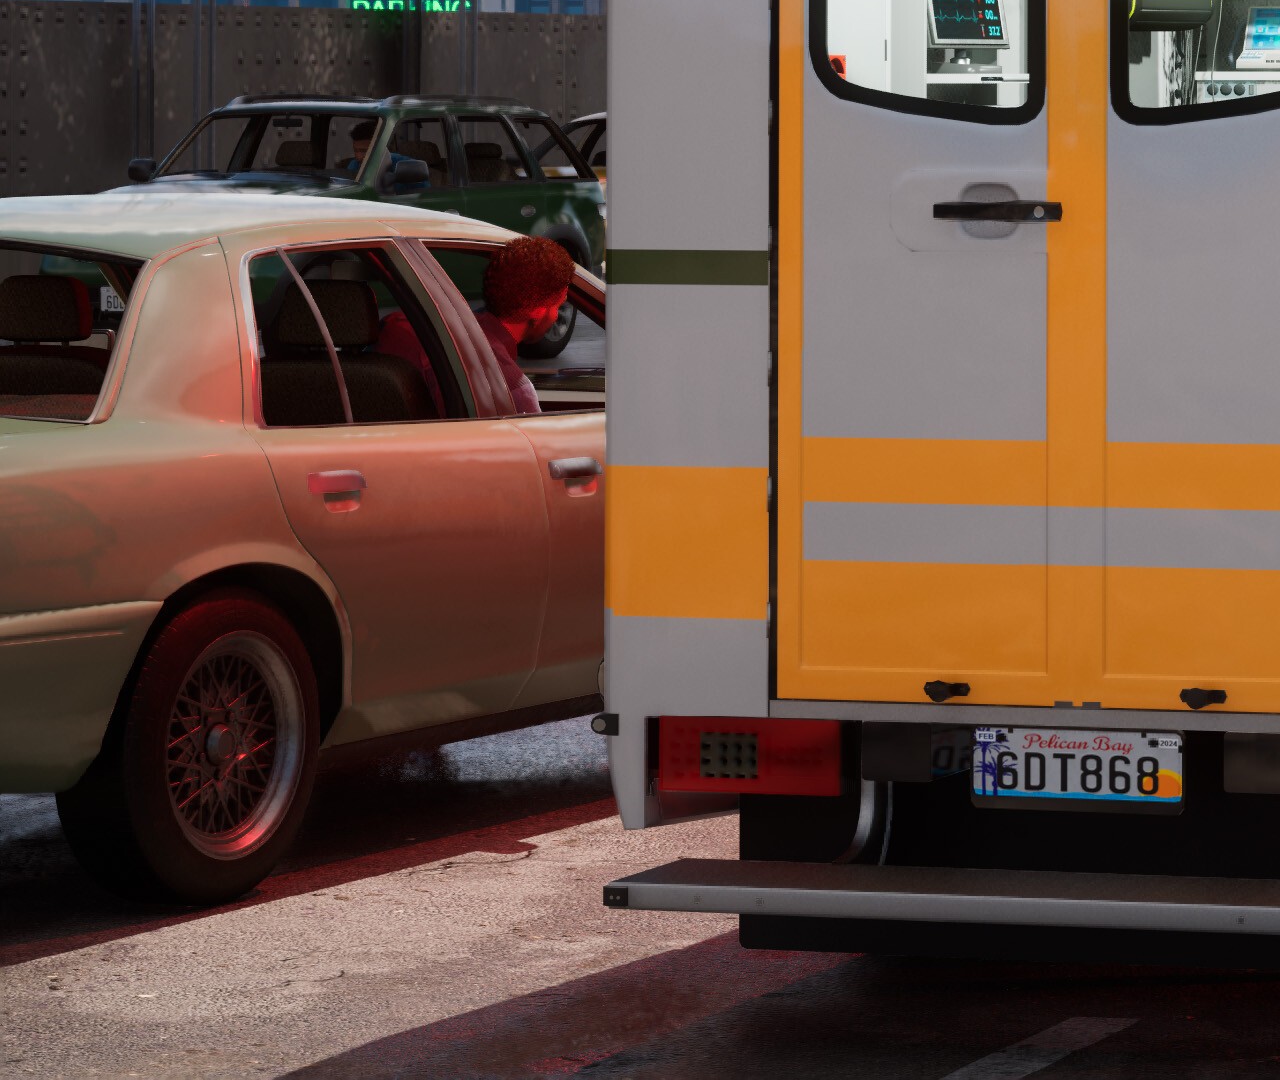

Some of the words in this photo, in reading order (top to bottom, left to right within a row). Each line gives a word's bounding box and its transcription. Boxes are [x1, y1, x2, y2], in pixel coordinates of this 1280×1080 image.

[1022, 733, 1088, 751] Pelican
[1091, 735, 1134, 755] Bay
[996, 751, 1159, 796] 6DT868
